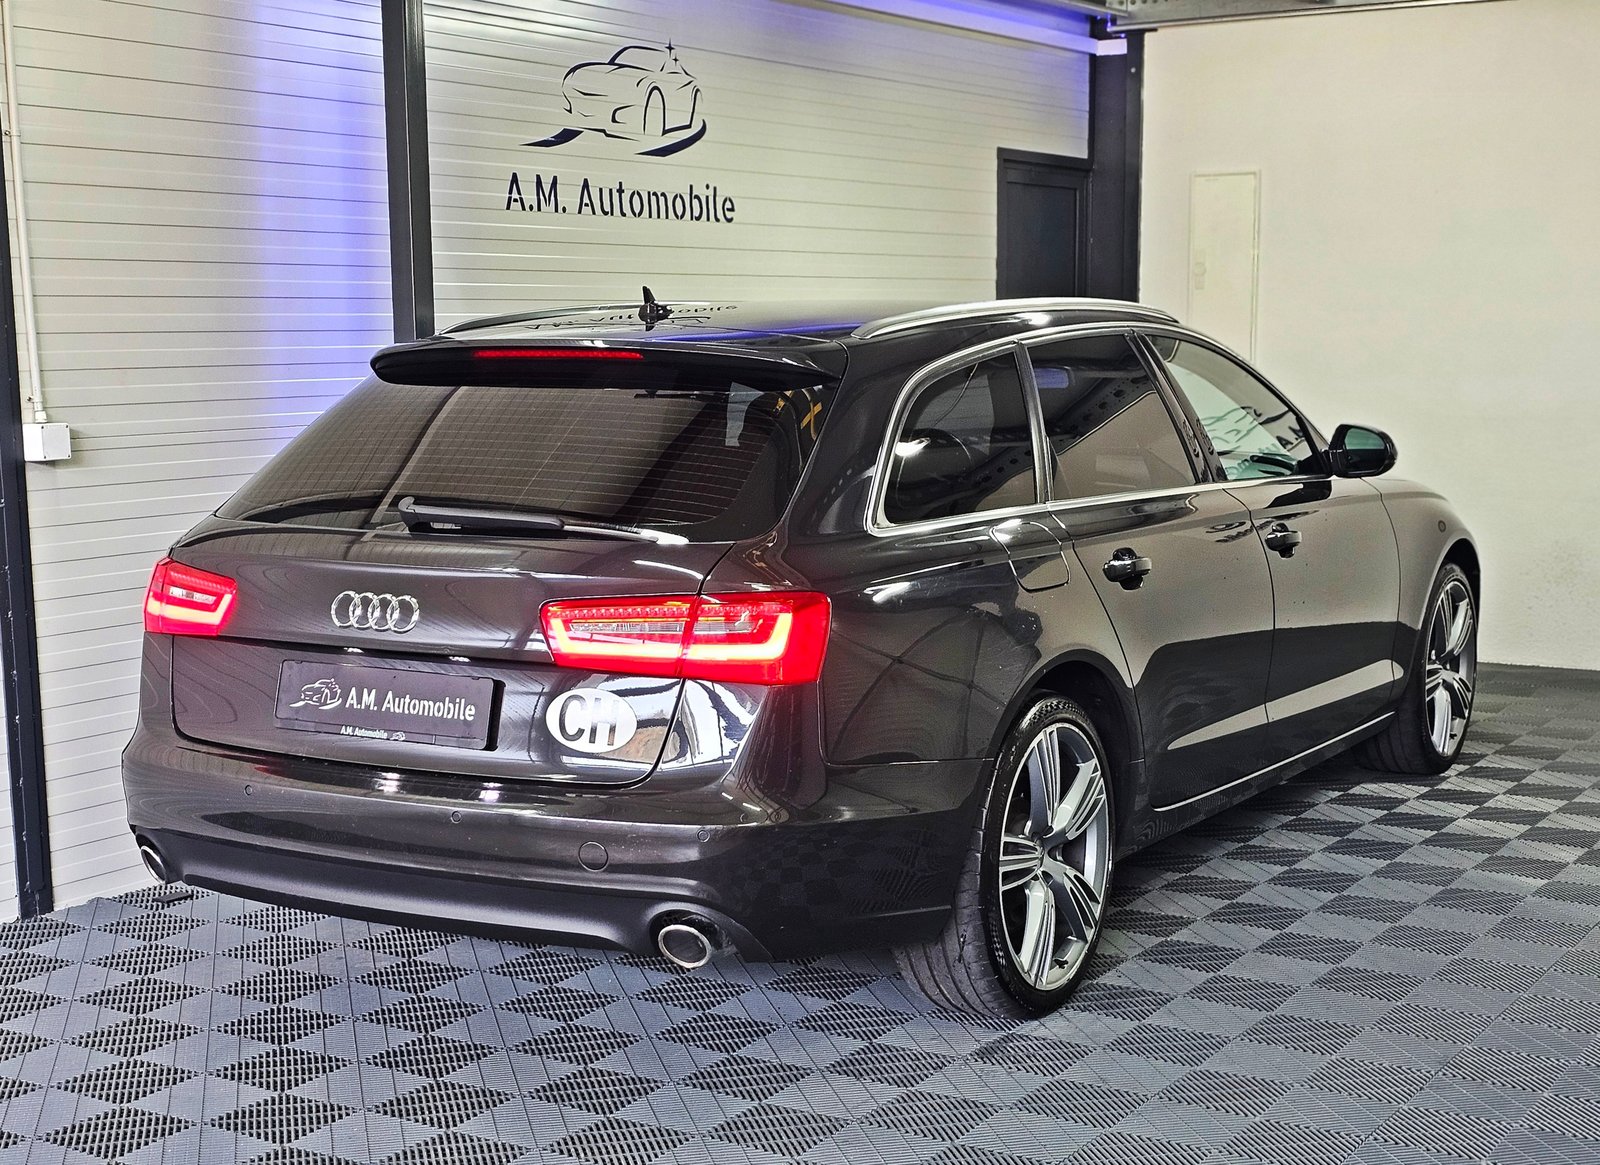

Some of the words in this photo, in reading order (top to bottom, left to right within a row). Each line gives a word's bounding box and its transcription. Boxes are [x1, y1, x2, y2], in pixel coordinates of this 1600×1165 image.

[505, 171, 567, 214] A.M.
[577, 177, 736, 223] Automobile
[345, 686, 378, 711] A.M.
[381, 690, 476, 721] Automobile
[558, 693, 620, 747] CH
[353, 726, 388, 739] Automobile
